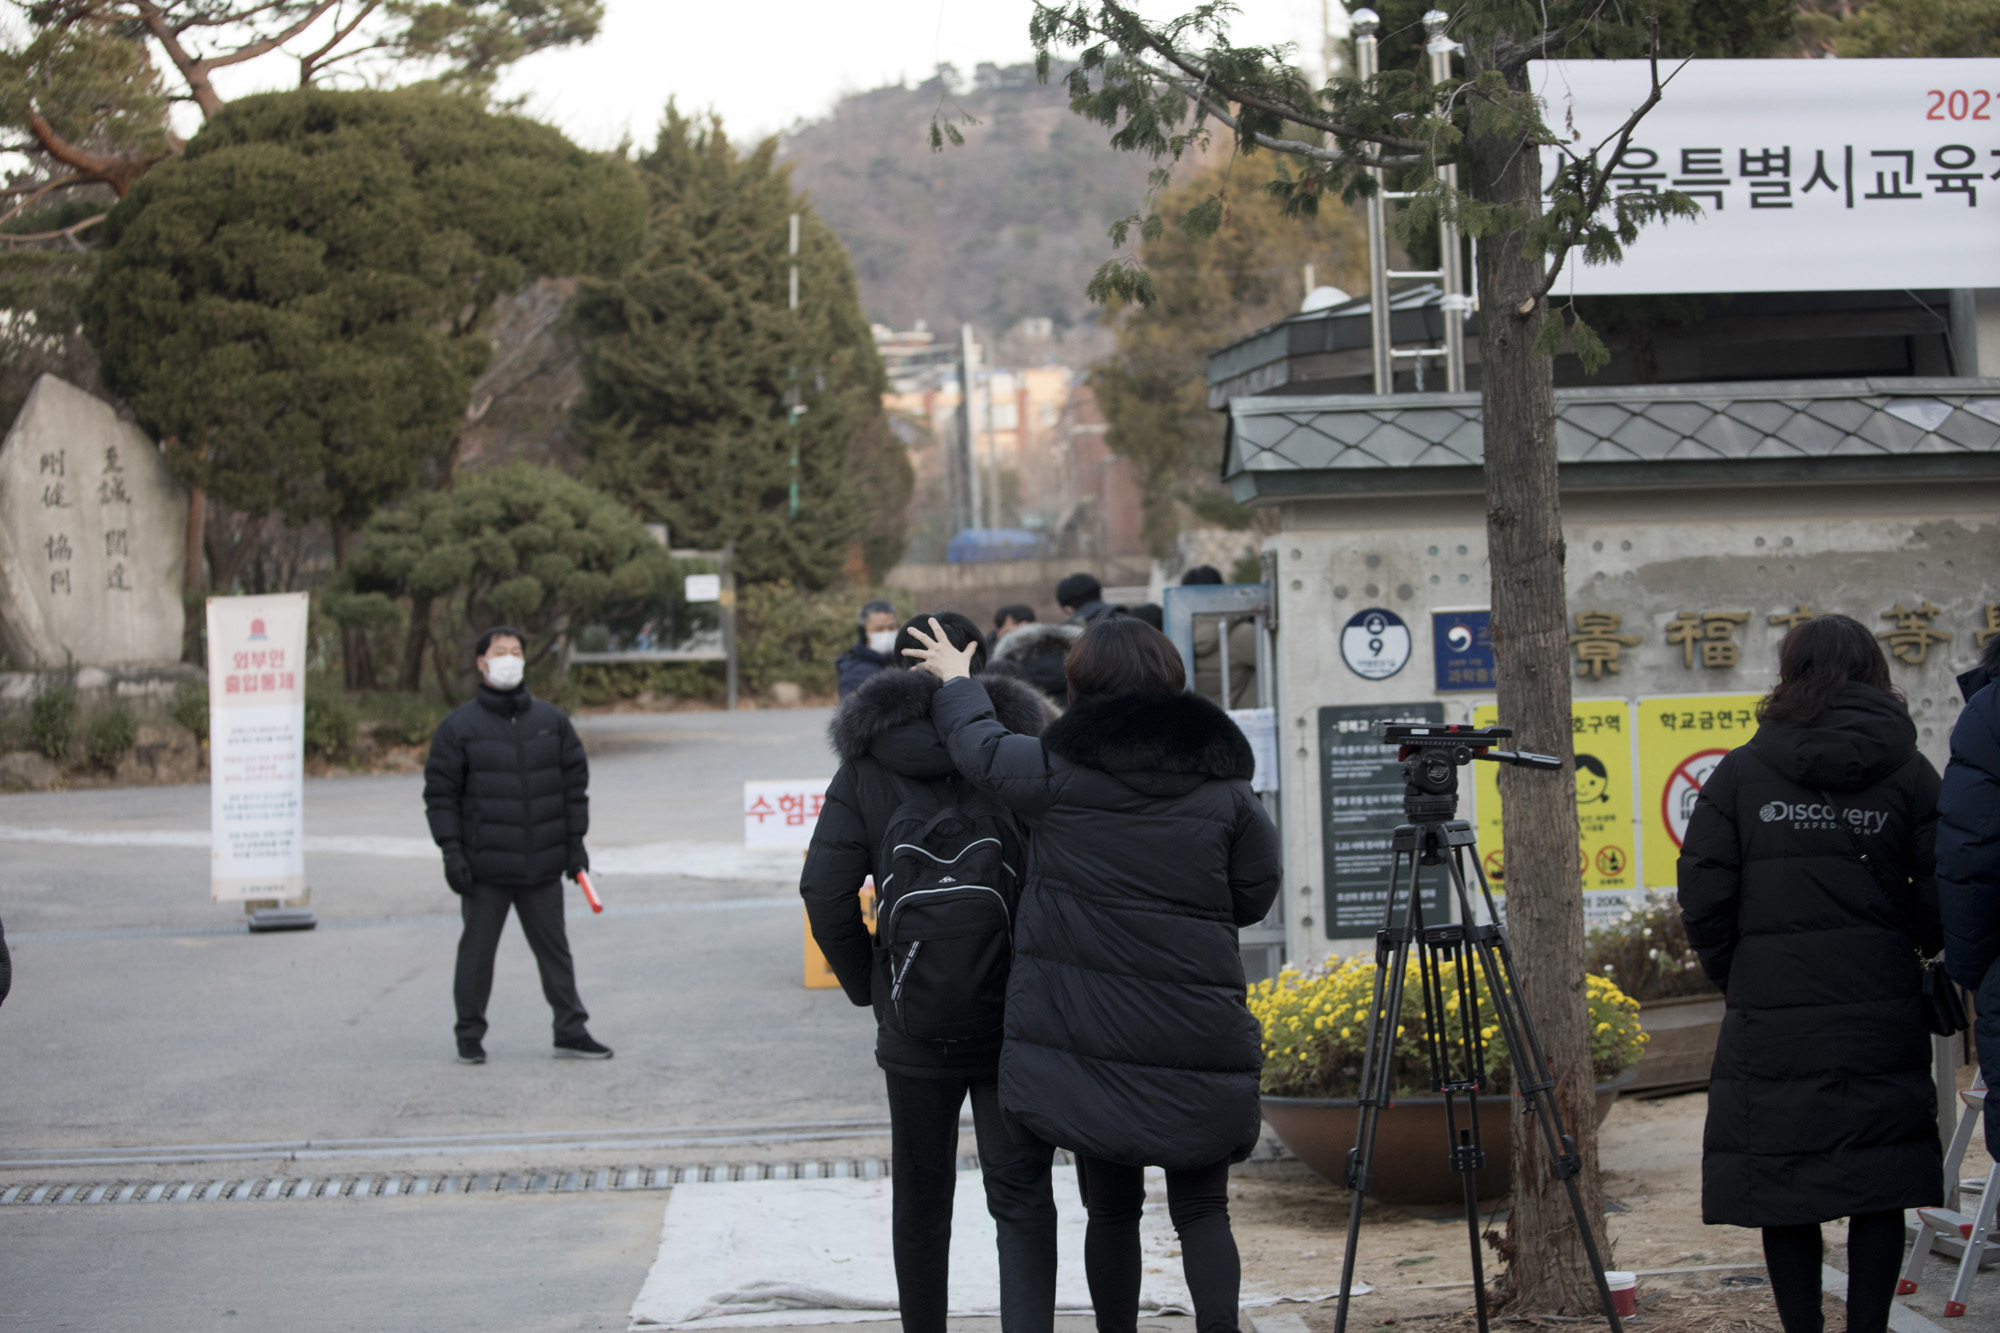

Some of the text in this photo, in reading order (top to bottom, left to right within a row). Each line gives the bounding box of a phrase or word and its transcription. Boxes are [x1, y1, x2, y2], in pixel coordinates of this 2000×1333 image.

[1544, 144, 2000, 210] 울특별시교육
[233, 648, 285, 670] 외부인
[1368, 638, 1384, 658] 9
[225, 672, 295, 694] 출입통제
[1659, 709, 1758, 732] 학교금연구
[1793, 821, 1872, 836] EXPEDON
